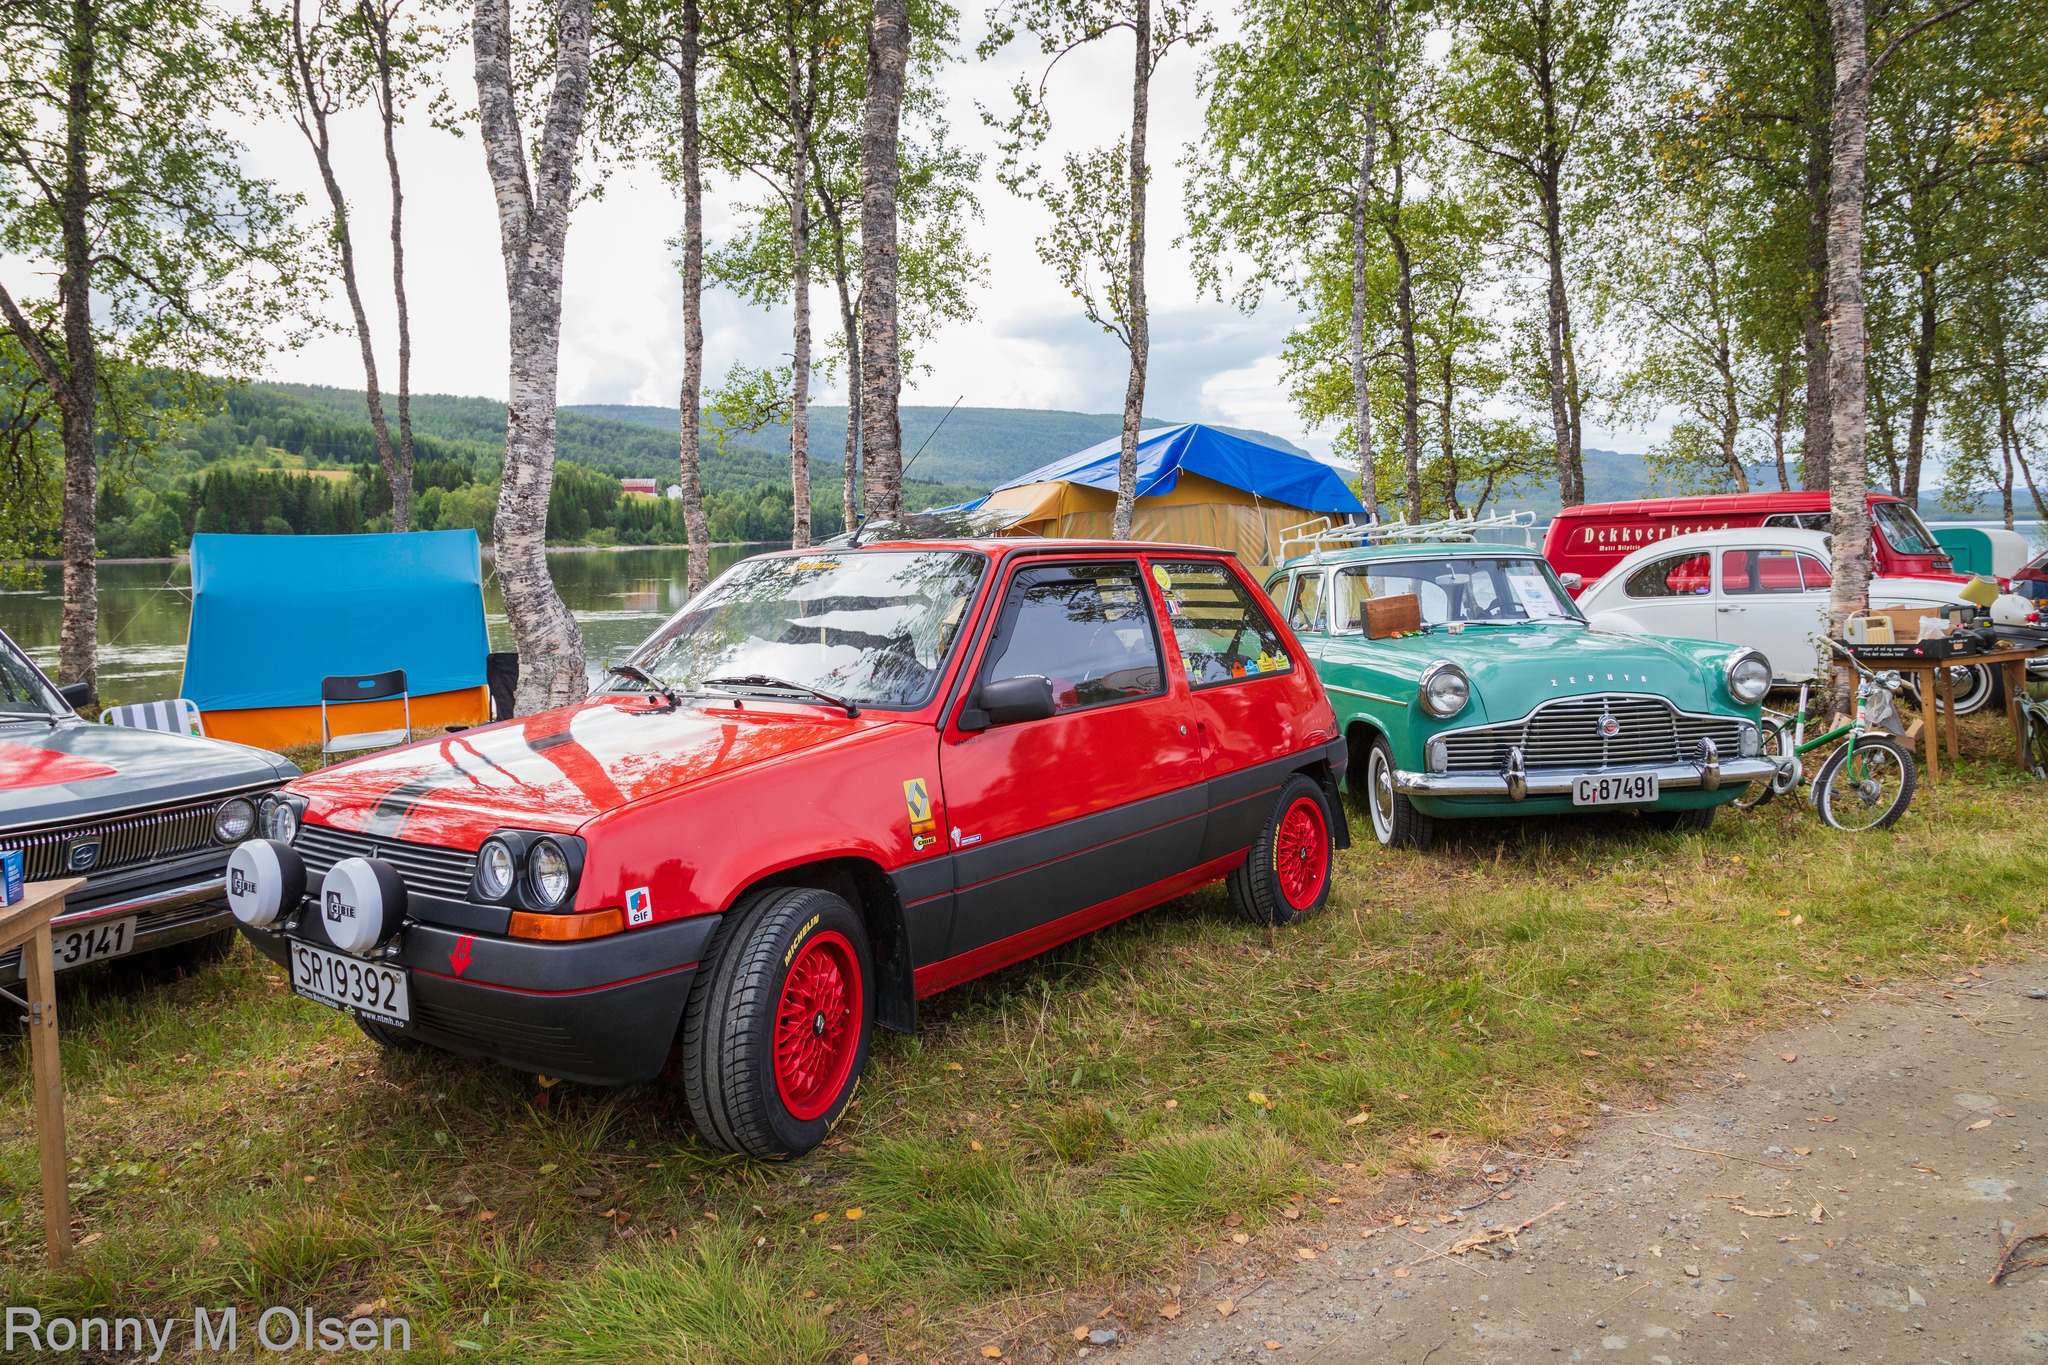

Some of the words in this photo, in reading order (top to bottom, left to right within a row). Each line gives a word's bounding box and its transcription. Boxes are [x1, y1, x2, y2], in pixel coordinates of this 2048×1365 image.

[1551, 674, 1647, 686] ZEPHYR
[785, 914, 820, 967] MICHELIN
[361, 1010, 405, 1028] www.ntmh.no
